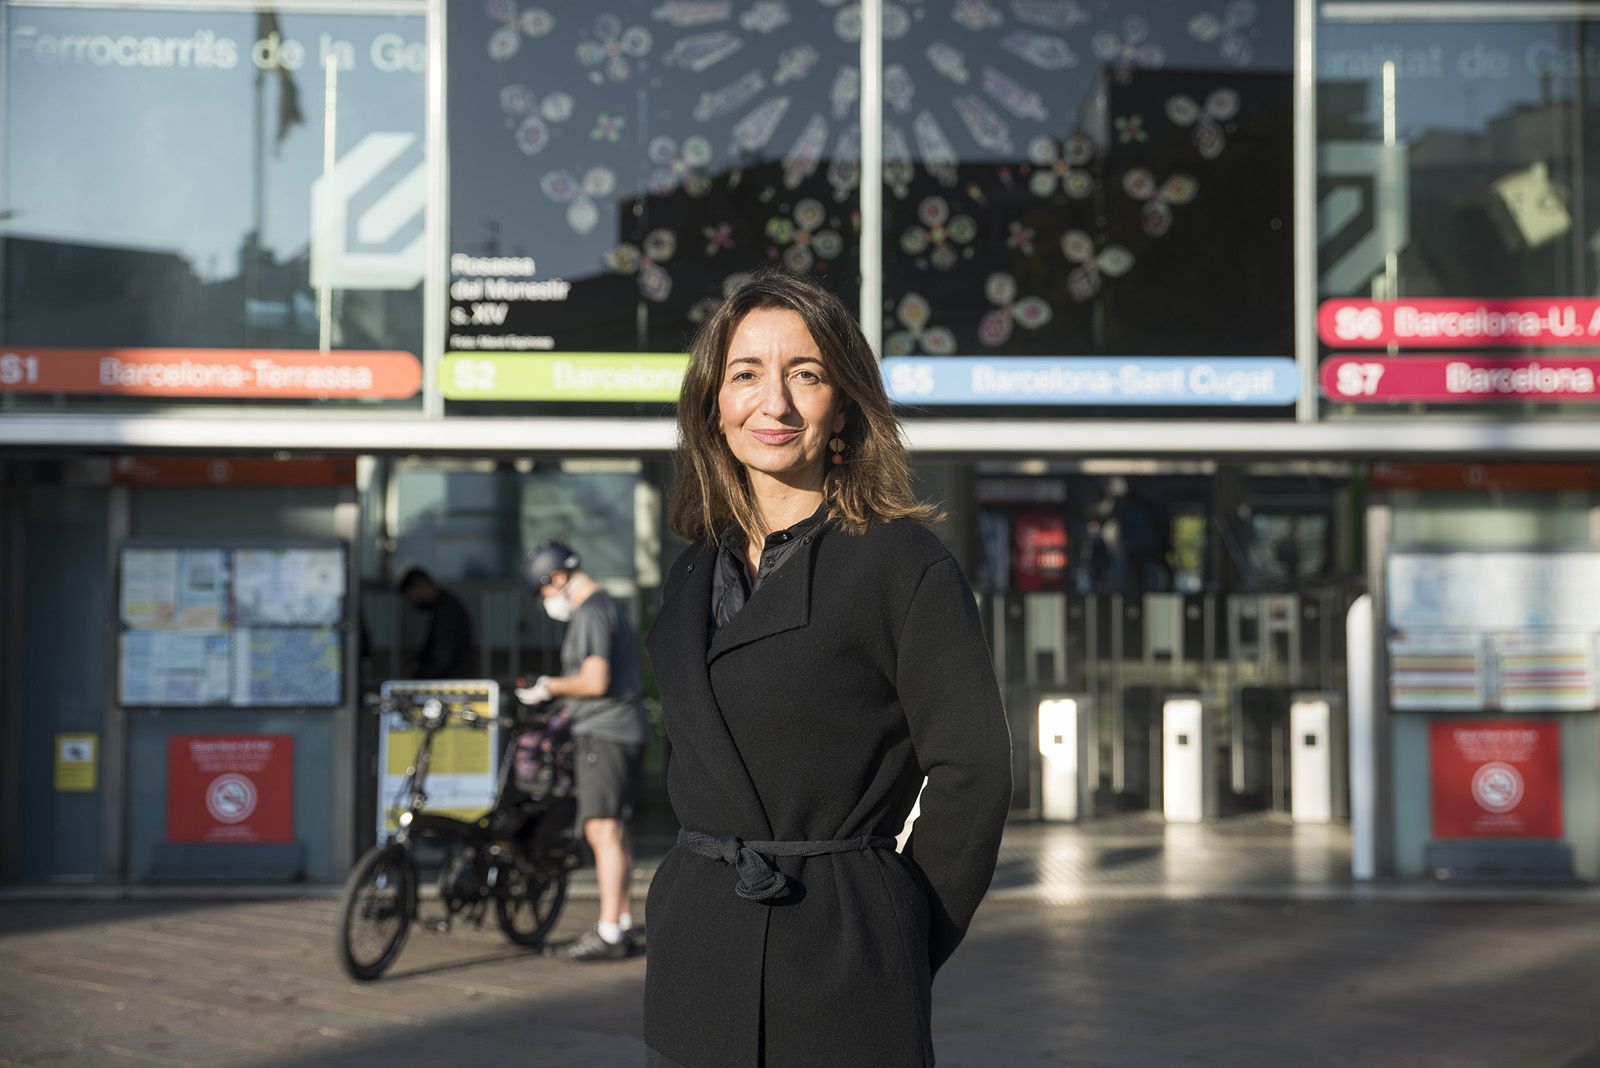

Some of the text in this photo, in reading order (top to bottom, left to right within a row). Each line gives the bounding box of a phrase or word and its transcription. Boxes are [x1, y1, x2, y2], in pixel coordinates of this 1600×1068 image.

[14, 25, 239, 69] Ferrocarrils
[252, 31, 305, 70] de
[320, 31, 356, 71] la
[1335, 306, 1383, 340] S6
[0, 352, 373, 390] S1 Barcelona-Terrassa
[454, 360, 498, 390] S2
[1189, 364, 1275, 401] Cugat
[1337, 361, 1595, 396] S7 Barcelona
